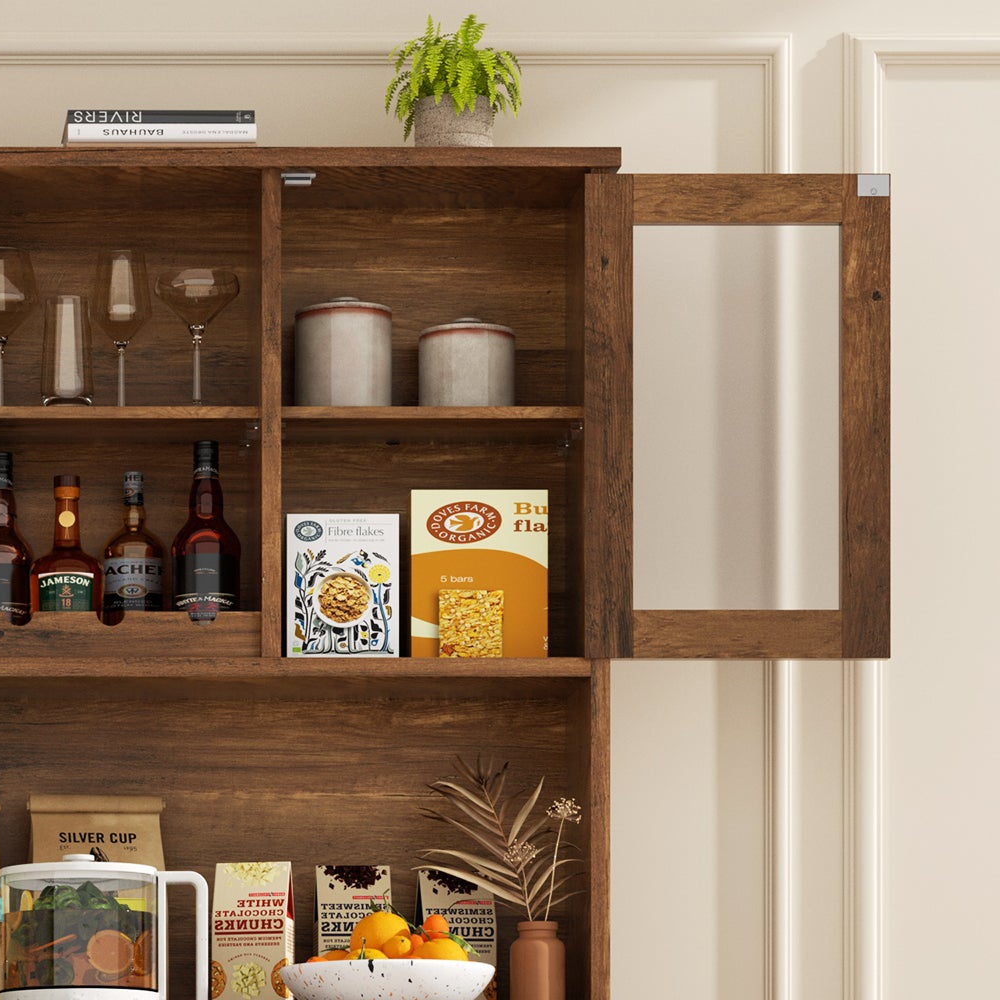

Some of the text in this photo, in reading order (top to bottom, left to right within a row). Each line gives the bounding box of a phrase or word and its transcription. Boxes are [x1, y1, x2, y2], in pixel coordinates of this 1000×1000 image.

[74, 111, 142, 123] RIVERS
[431, 503, 497, 529] DOVES FARM
[328, 526, 384, 537] Fibre flakes
[513, 519, 548, 532] fla
[438, 522, 497, 542] ORGANIC
[40, 575, 92, 588] JAMESON
[440, 575, 474, 583] 5 bars
[61, 598, 71, 608] 18
[59, 832, 137, 844] SILVER CUP
